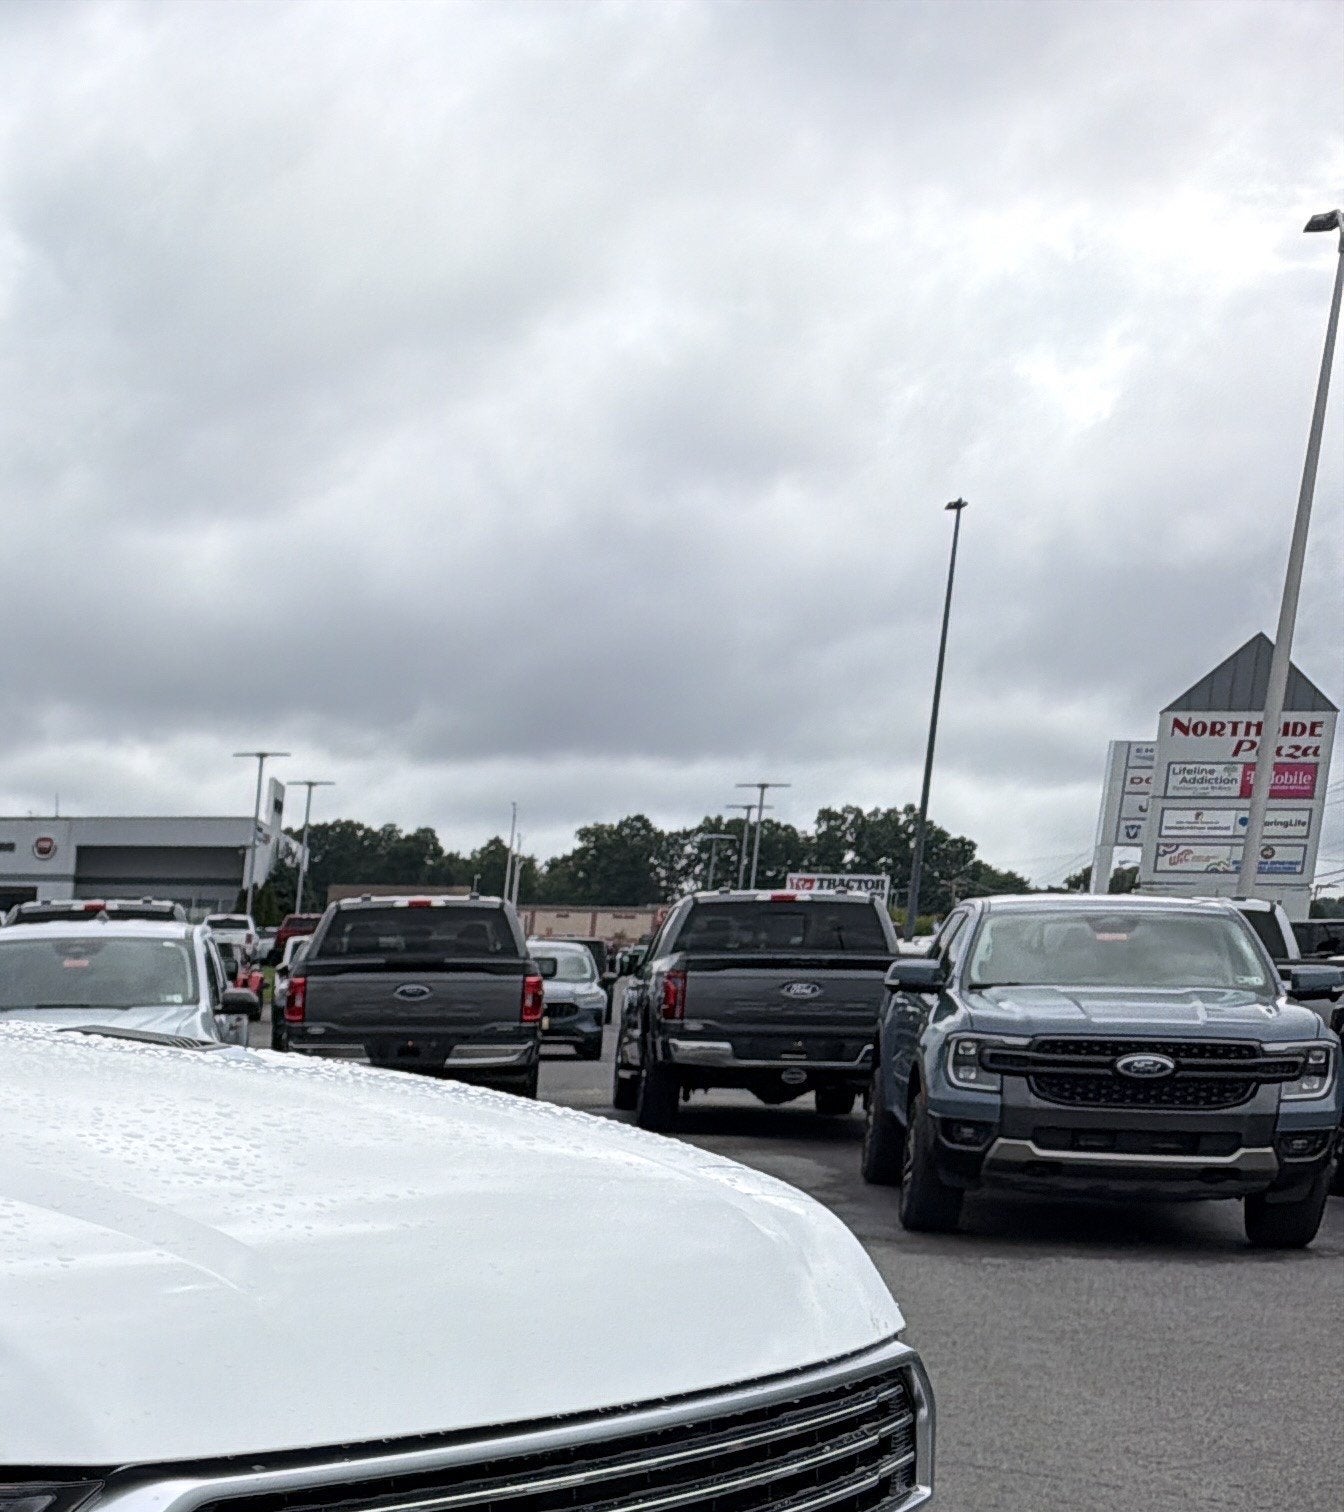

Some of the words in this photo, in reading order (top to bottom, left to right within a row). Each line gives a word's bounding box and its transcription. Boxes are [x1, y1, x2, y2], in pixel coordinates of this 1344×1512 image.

[1170, 717, 1325, 738] NORTHIDE
[1172, 766, 1216, 775] Lifeline
[1179, 775, 1239, 785] Addiction
[1263, 819, 1307, 829] aringLife
[815, 878, 886, 892] TRACTOR
